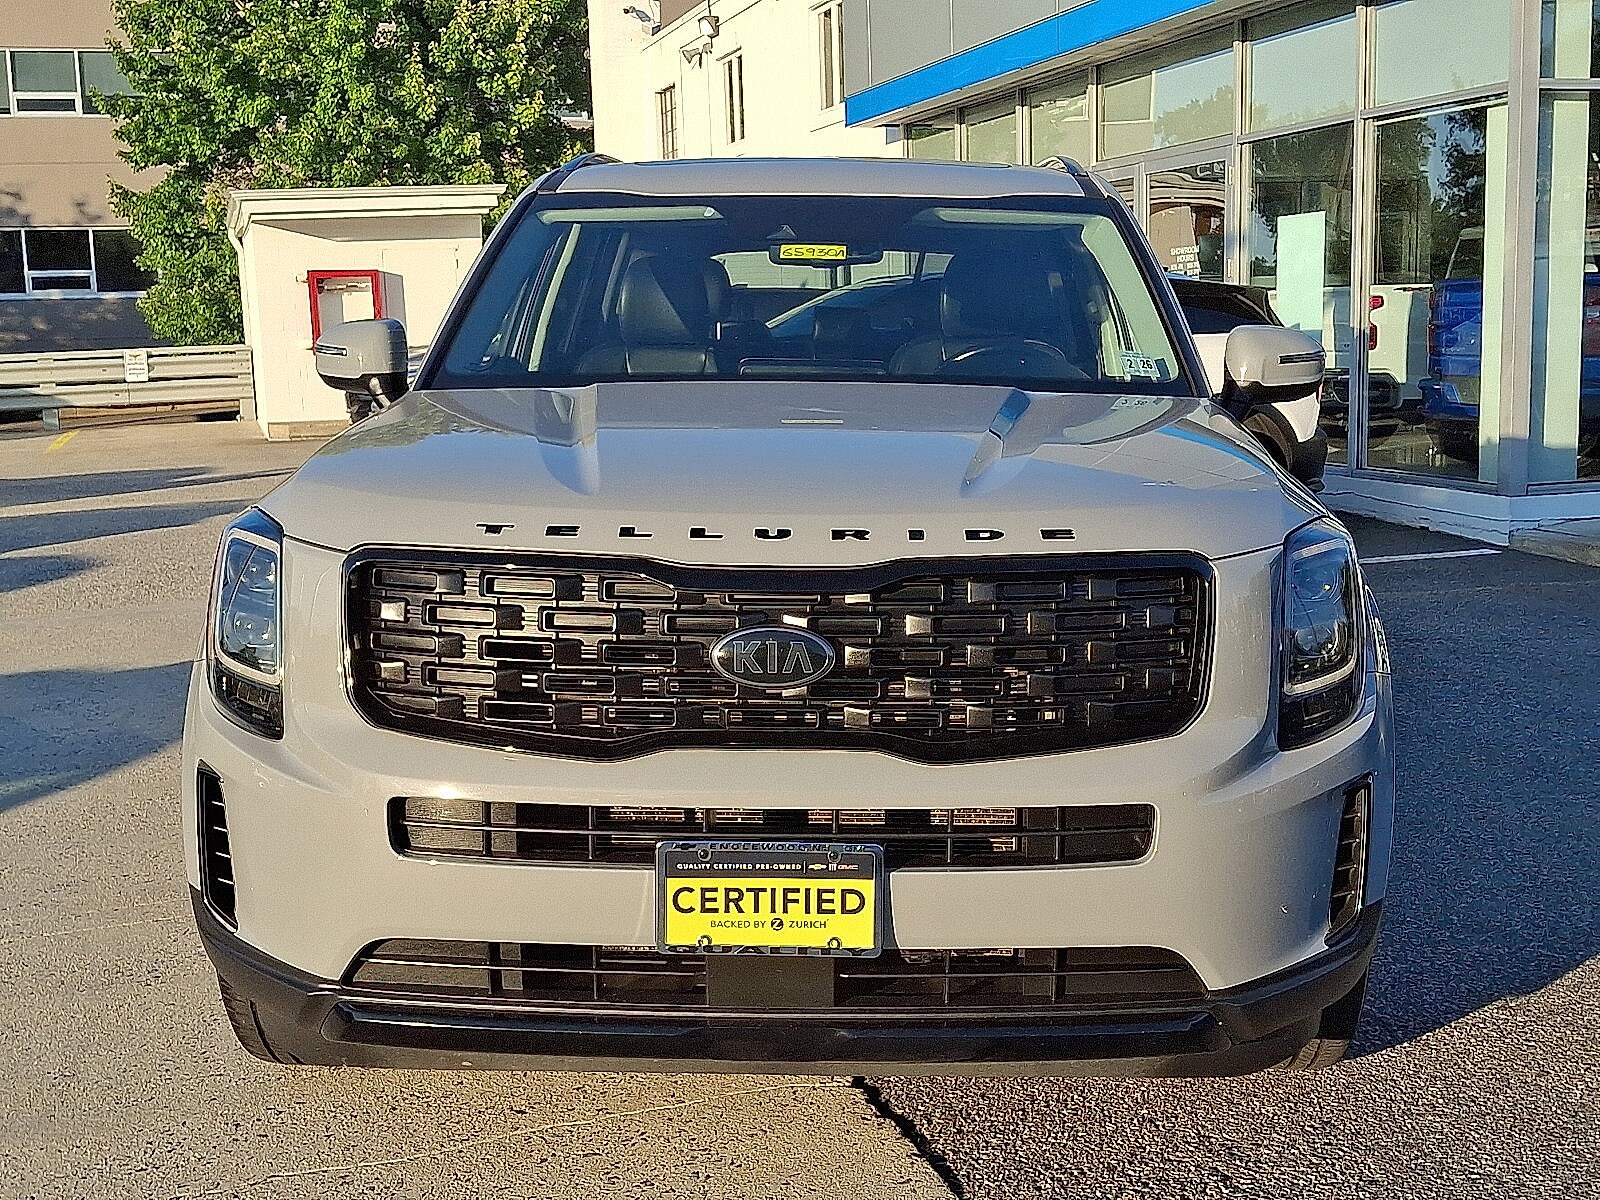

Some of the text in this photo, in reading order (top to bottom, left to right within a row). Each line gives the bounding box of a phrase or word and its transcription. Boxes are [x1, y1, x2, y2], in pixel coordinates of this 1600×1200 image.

[1126, 358, 1153, 370] 2 26
[475, 522, 1077, 541] TELLURIDE
[733, 640, 813, 673] KIA
[676, 862, 802, 871] QUALITY CERTIFIED PRE-OWNED
[672, 886, 866, 915] CERTIFIED
[710, 920, 752, 929] BACKED
[753, 920, 767, 929] BY
